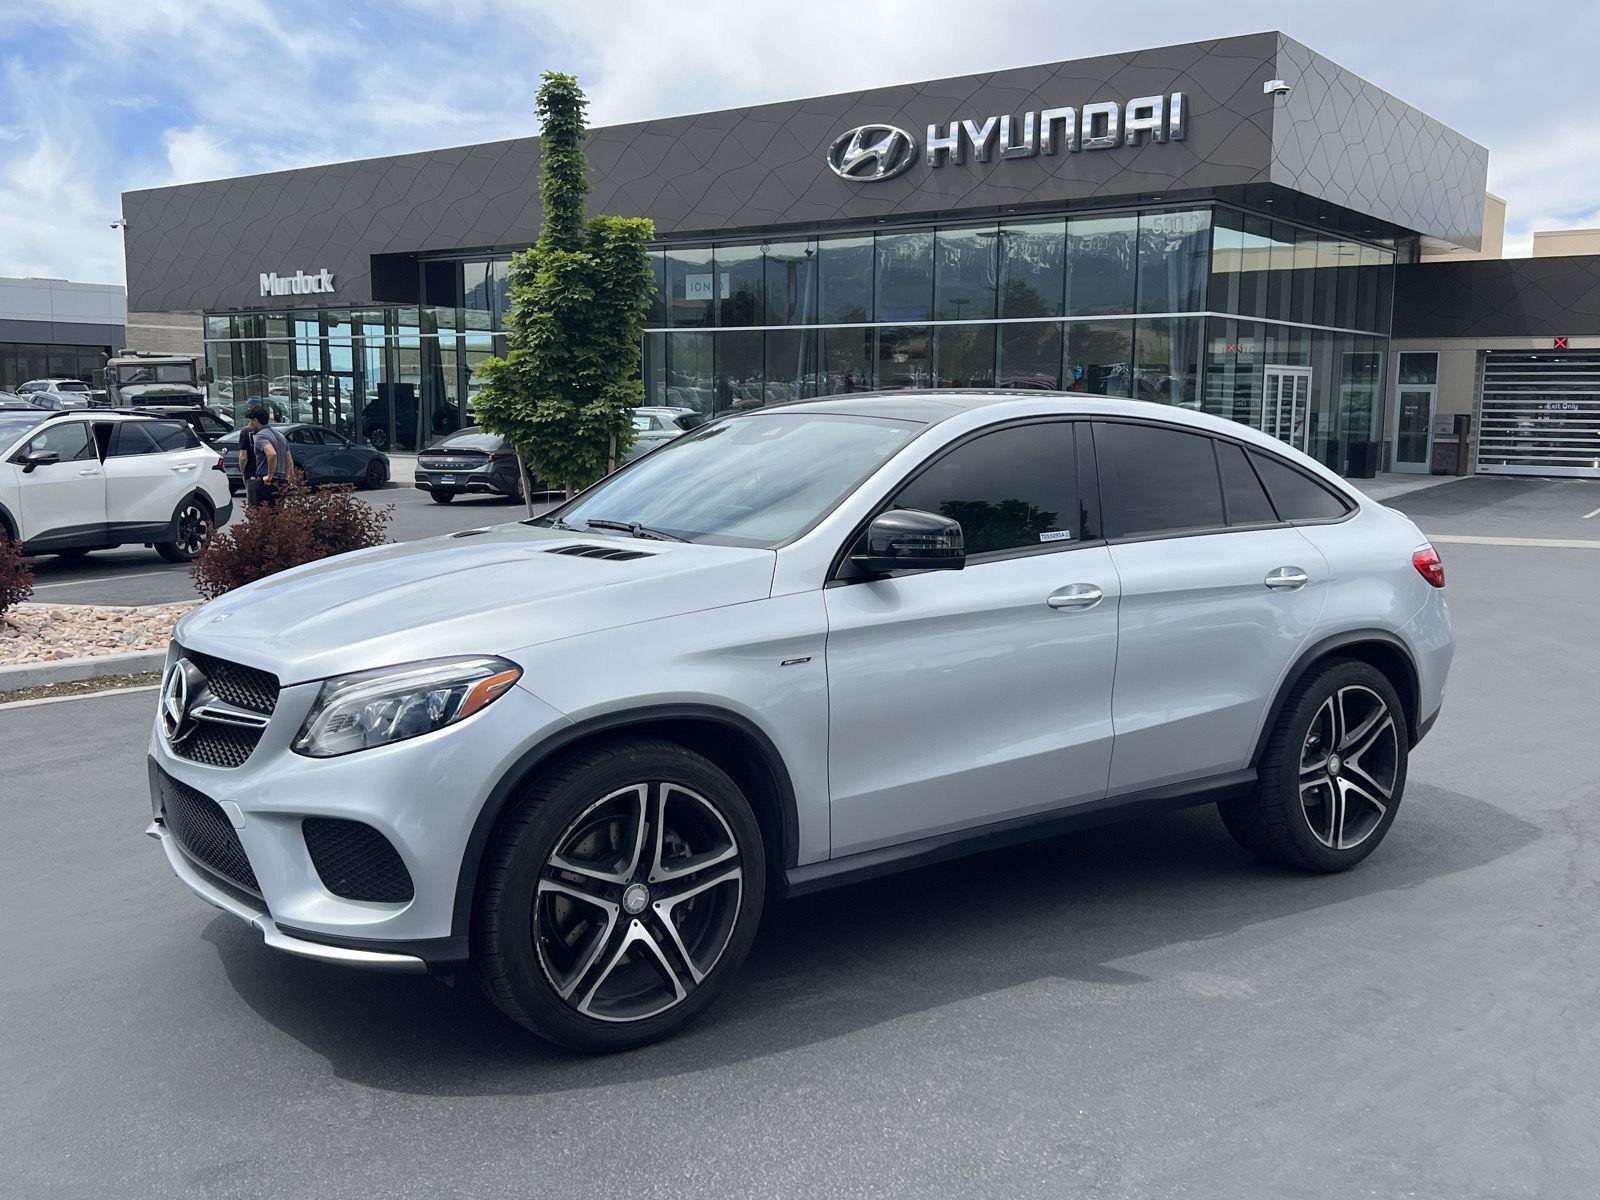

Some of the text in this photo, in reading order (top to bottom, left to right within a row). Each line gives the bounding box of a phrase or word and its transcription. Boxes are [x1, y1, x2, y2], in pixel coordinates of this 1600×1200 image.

[927, 92, 1186, 168] HYUNDAI
[260, 268, 335, 297] Murdock
[690, 281, 724, 291] ION
[1546, 400, 1579, 411] Exit Only
